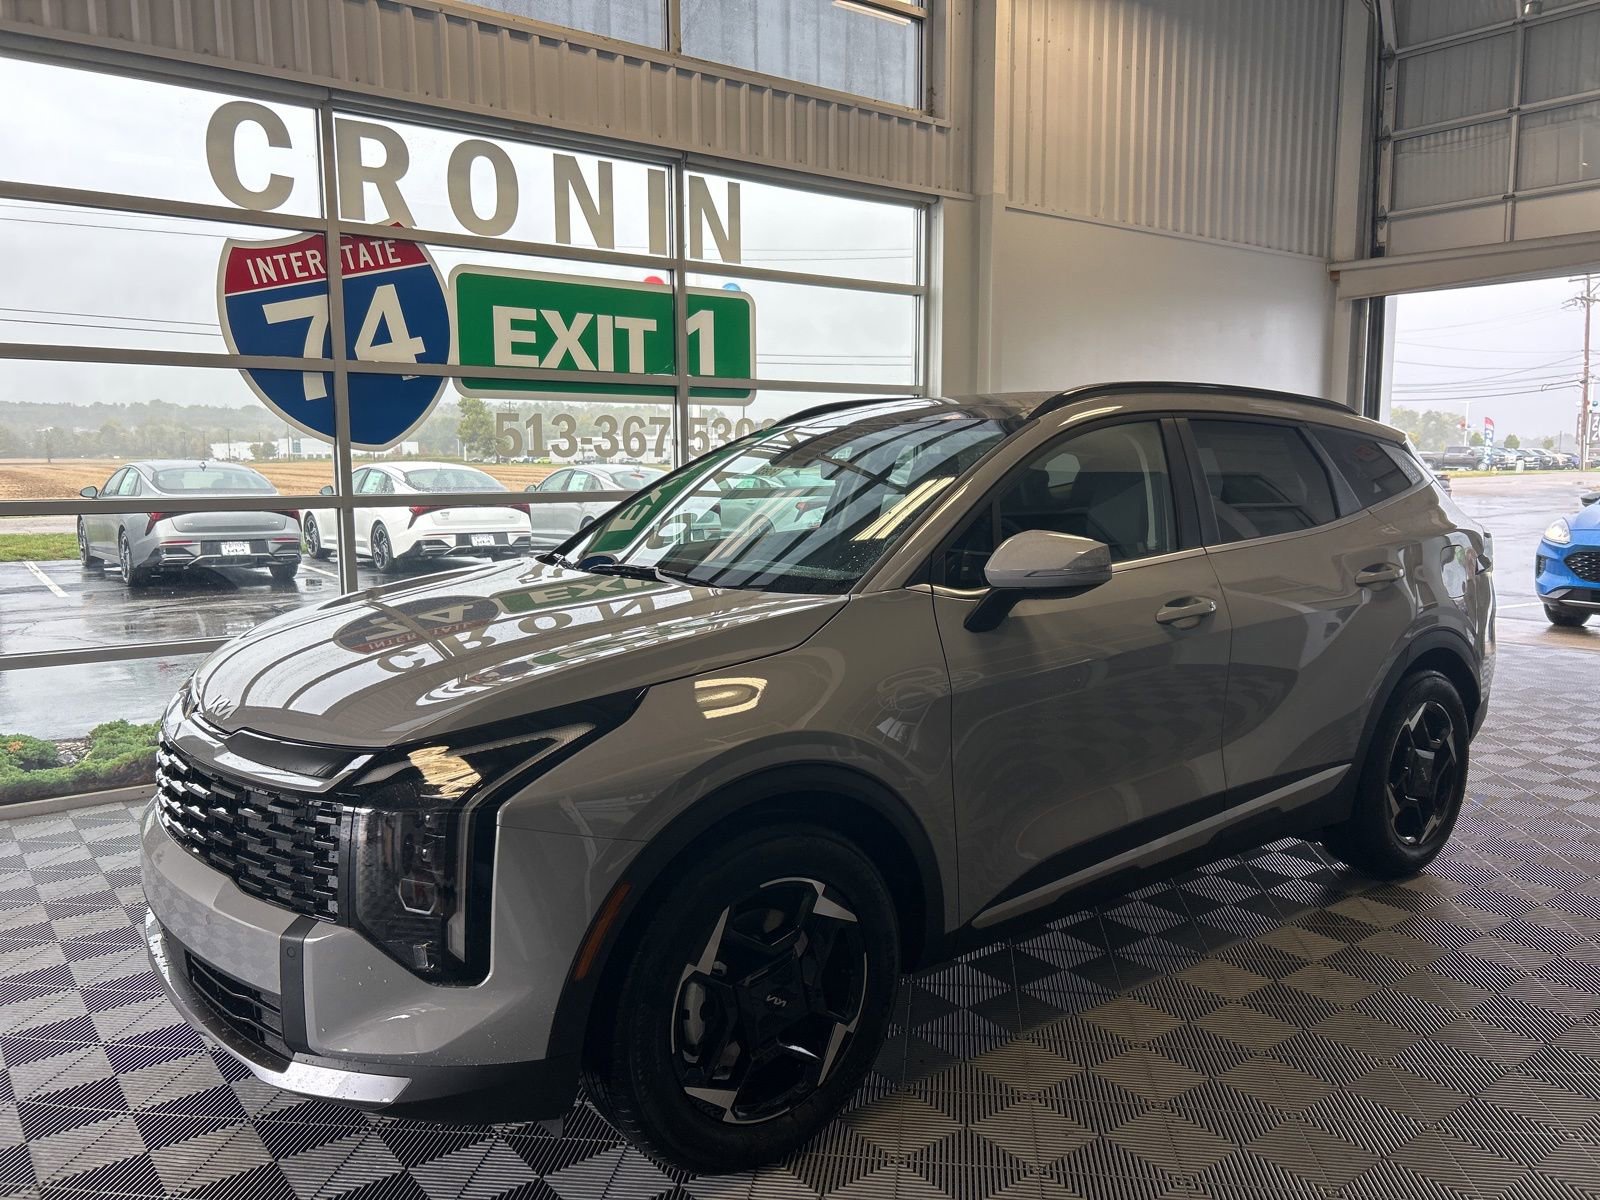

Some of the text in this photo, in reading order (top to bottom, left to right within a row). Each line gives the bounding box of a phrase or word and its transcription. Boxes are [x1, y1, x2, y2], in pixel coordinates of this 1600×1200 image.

[205, 100, 741, 264] CRONIN
[246, 240, 402, 285] INTERTATE
[262, 283, 426, 401] 74
[492, 305, 715, 376] EXIT 1
